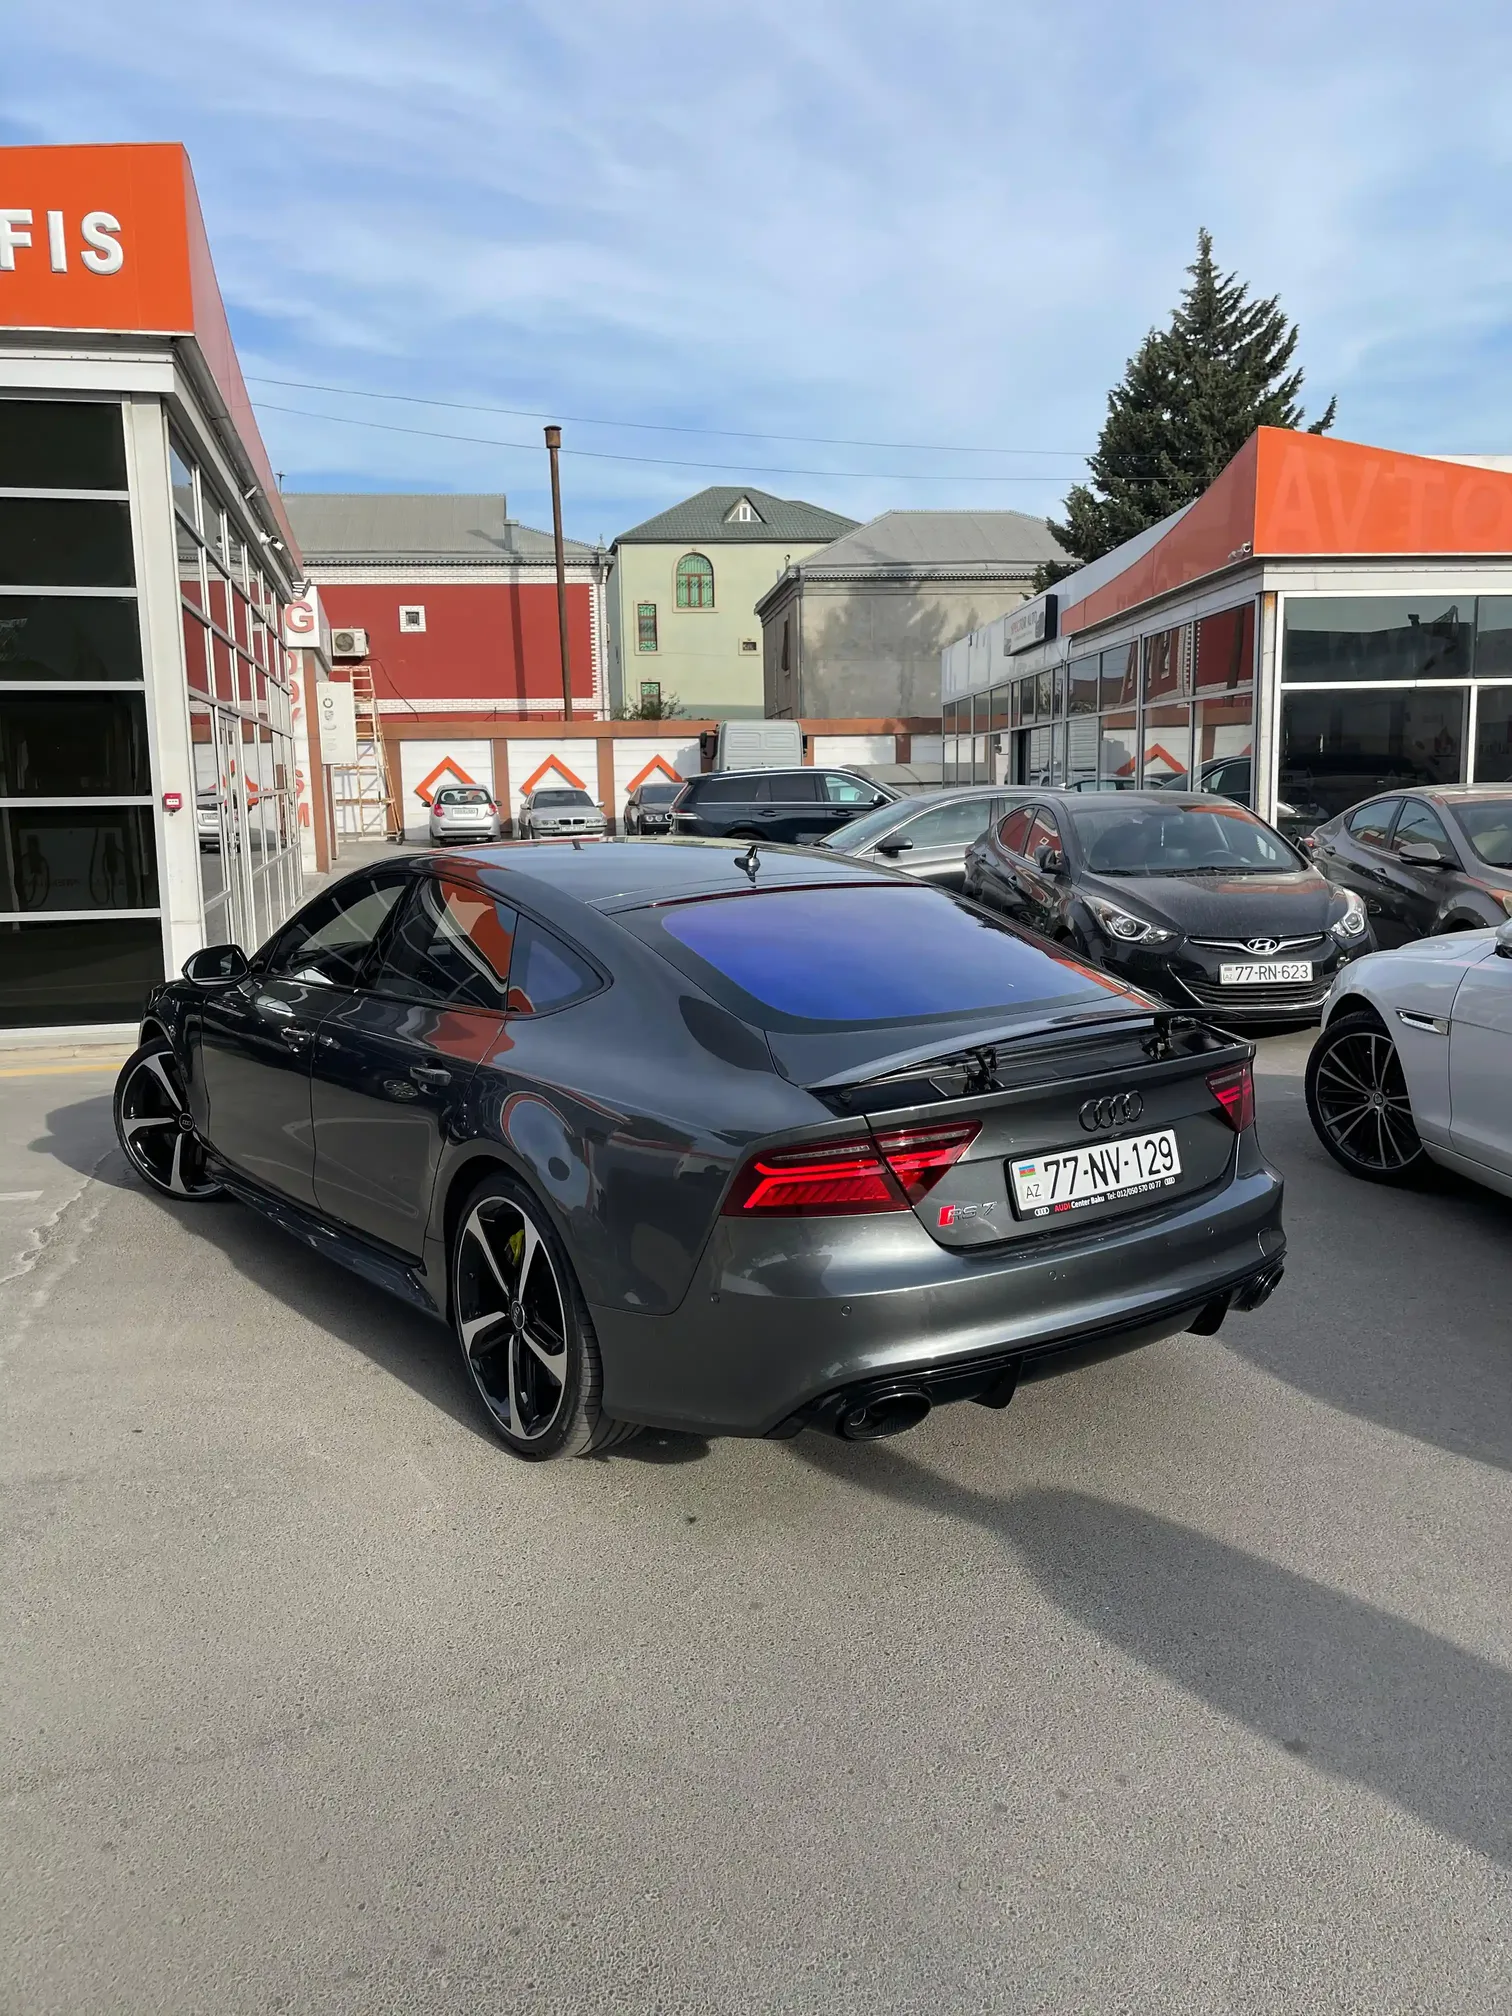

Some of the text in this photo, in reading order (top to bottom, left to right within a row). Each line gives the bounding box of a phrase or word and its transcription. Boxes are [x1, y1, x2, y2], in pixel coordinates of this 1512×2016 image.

[0, 209, 124, 276] FIS
[1265, 445, 1512, 552] AVTO
[1235, 964, 1309, 981] 77-RN-623
[1043, 1136, 1174, 1200] 77-NV-129
[1025, 1183, 1042, 1200] AZ
[1054, 1202, 1071, 1212] AUDI
[1070, 1198, 1091, 1209] Center
[1090, 1195, 1105, 1205] Baku
